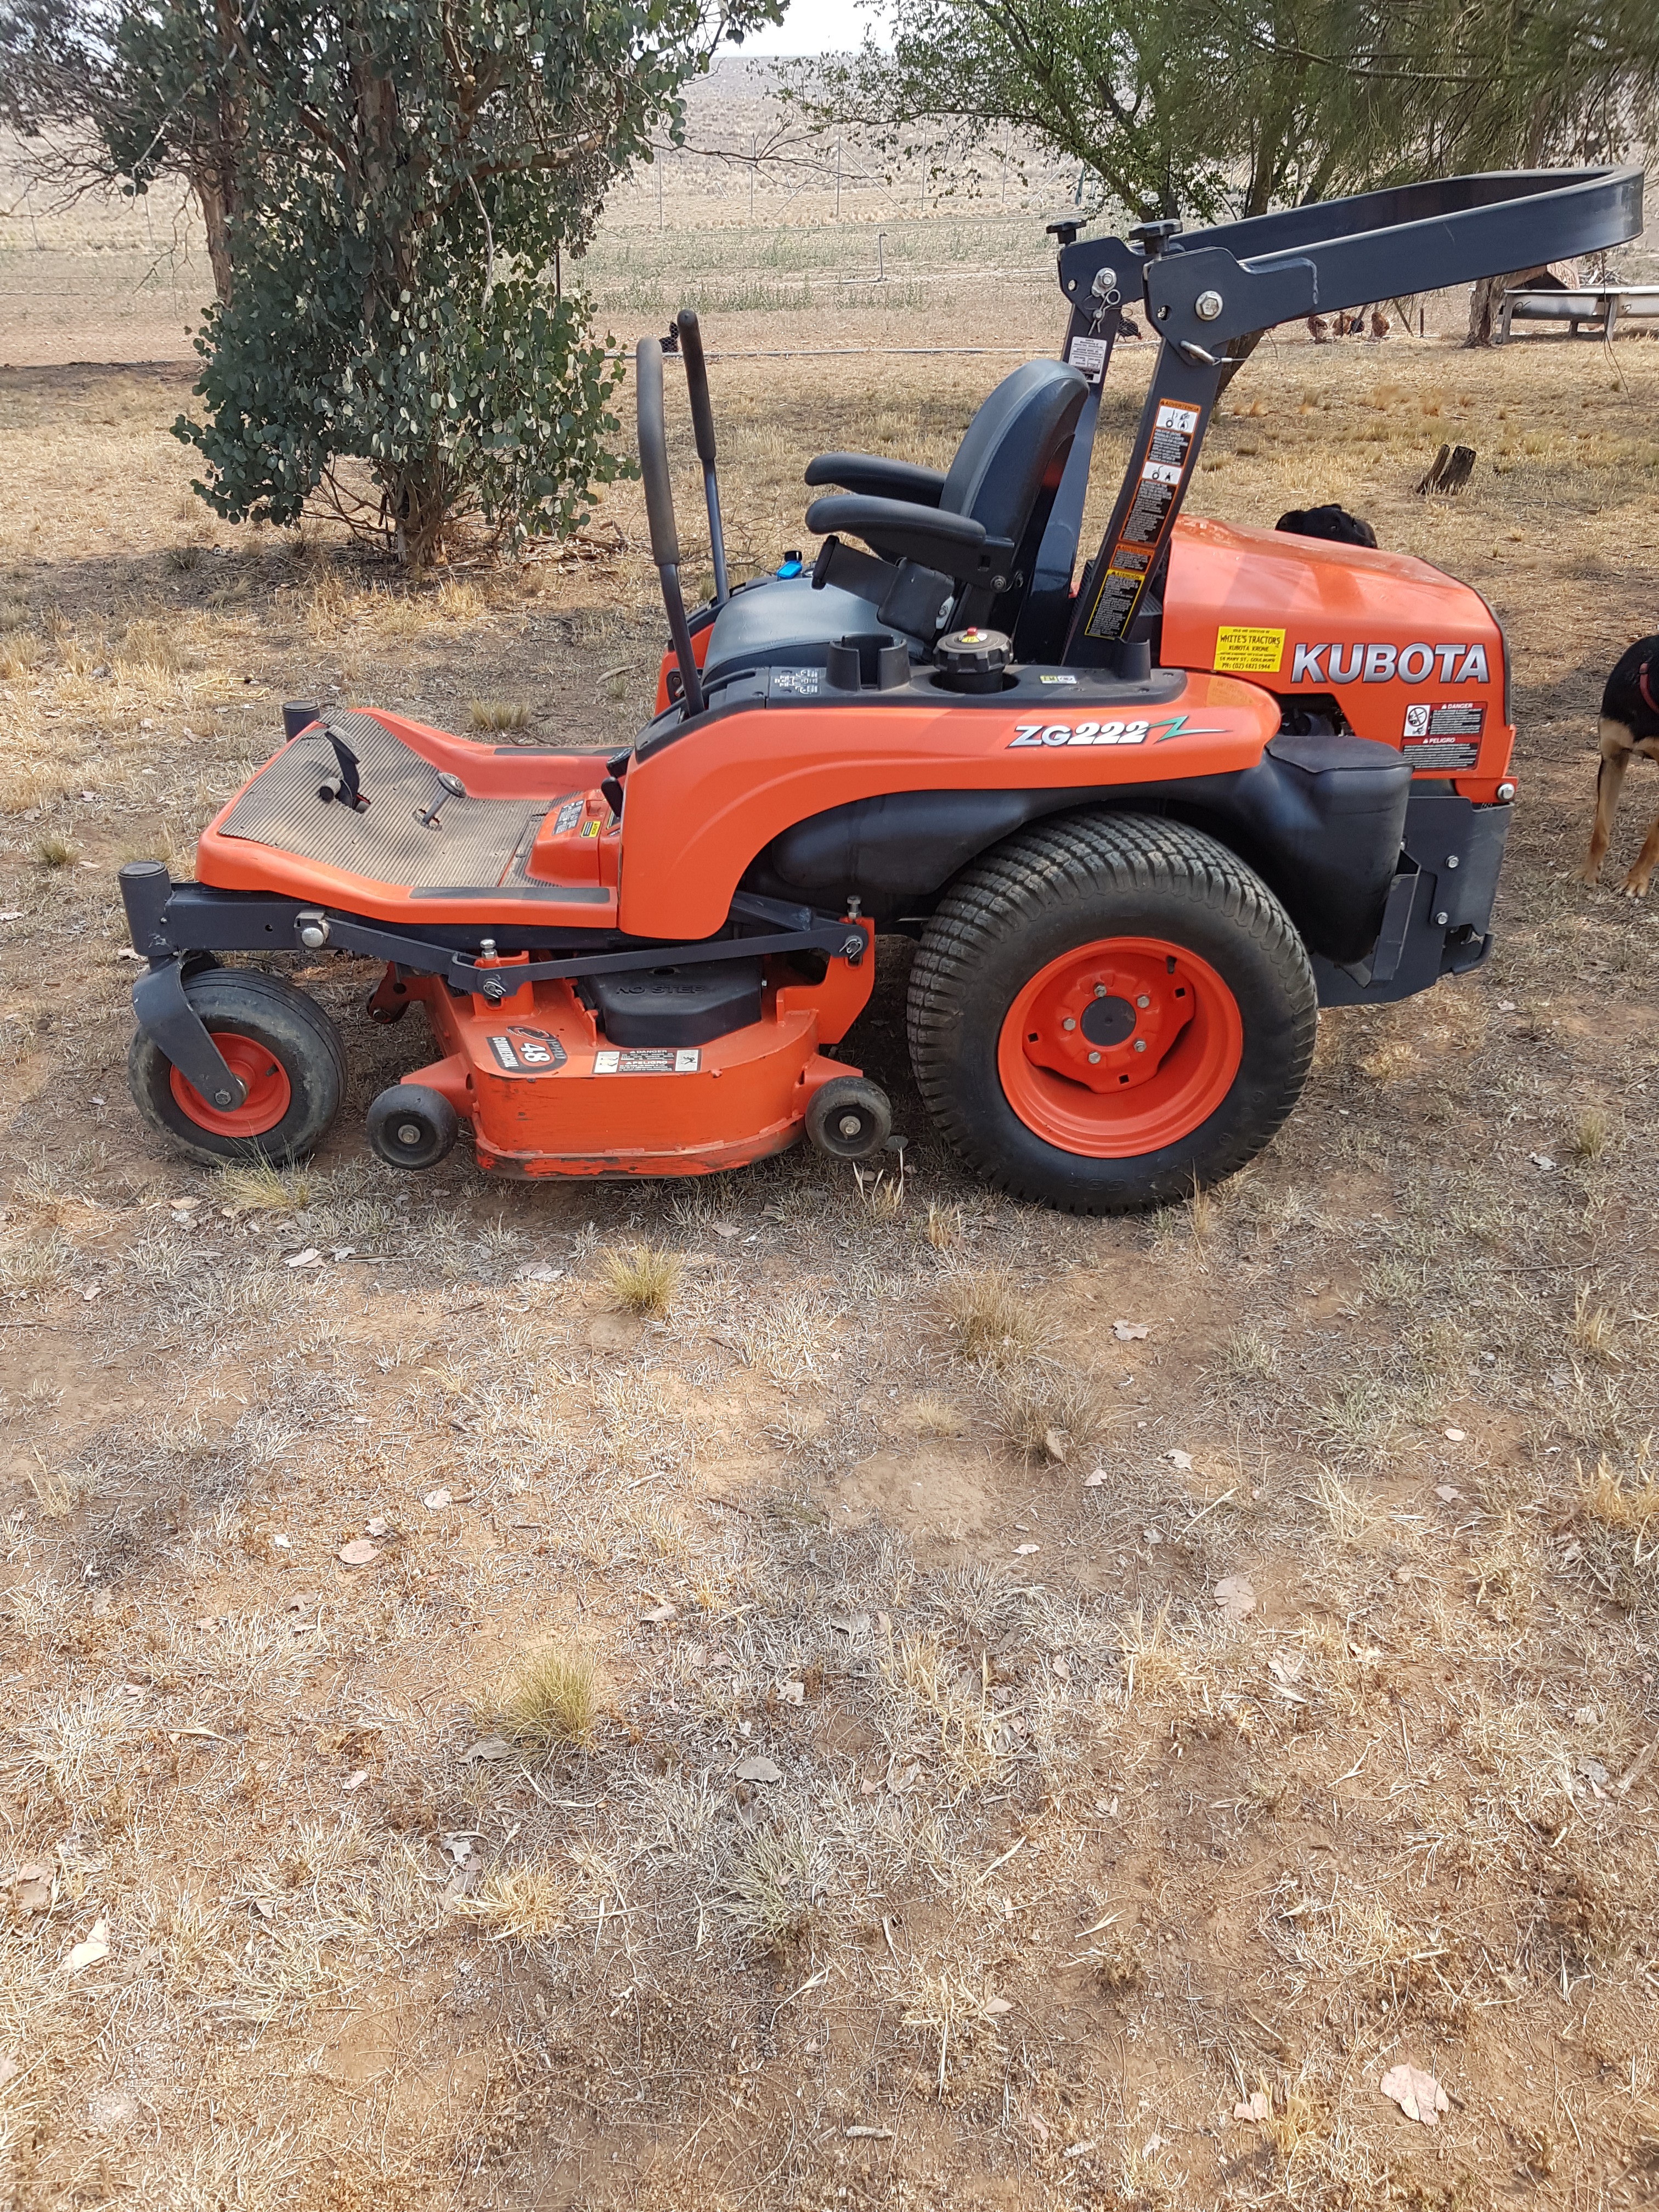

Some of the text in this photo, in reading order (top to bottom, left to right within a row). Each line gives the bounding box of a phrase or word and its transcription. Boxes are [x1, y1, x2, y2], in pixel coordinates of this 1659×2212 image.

[1220, 635, 1280, 645] WHITE'S TRACTORS
[1290, 642, 1491, 684] KUBOTA
[1006, 720, 1150, 748] ZG222
[616, 985, 705, 995] NO STEP
[492, 1037, 519, 1068] COMMERCIAL
[521, 1042, 550, 1062] 48
[549, 1041, 567, 1059] PRO
